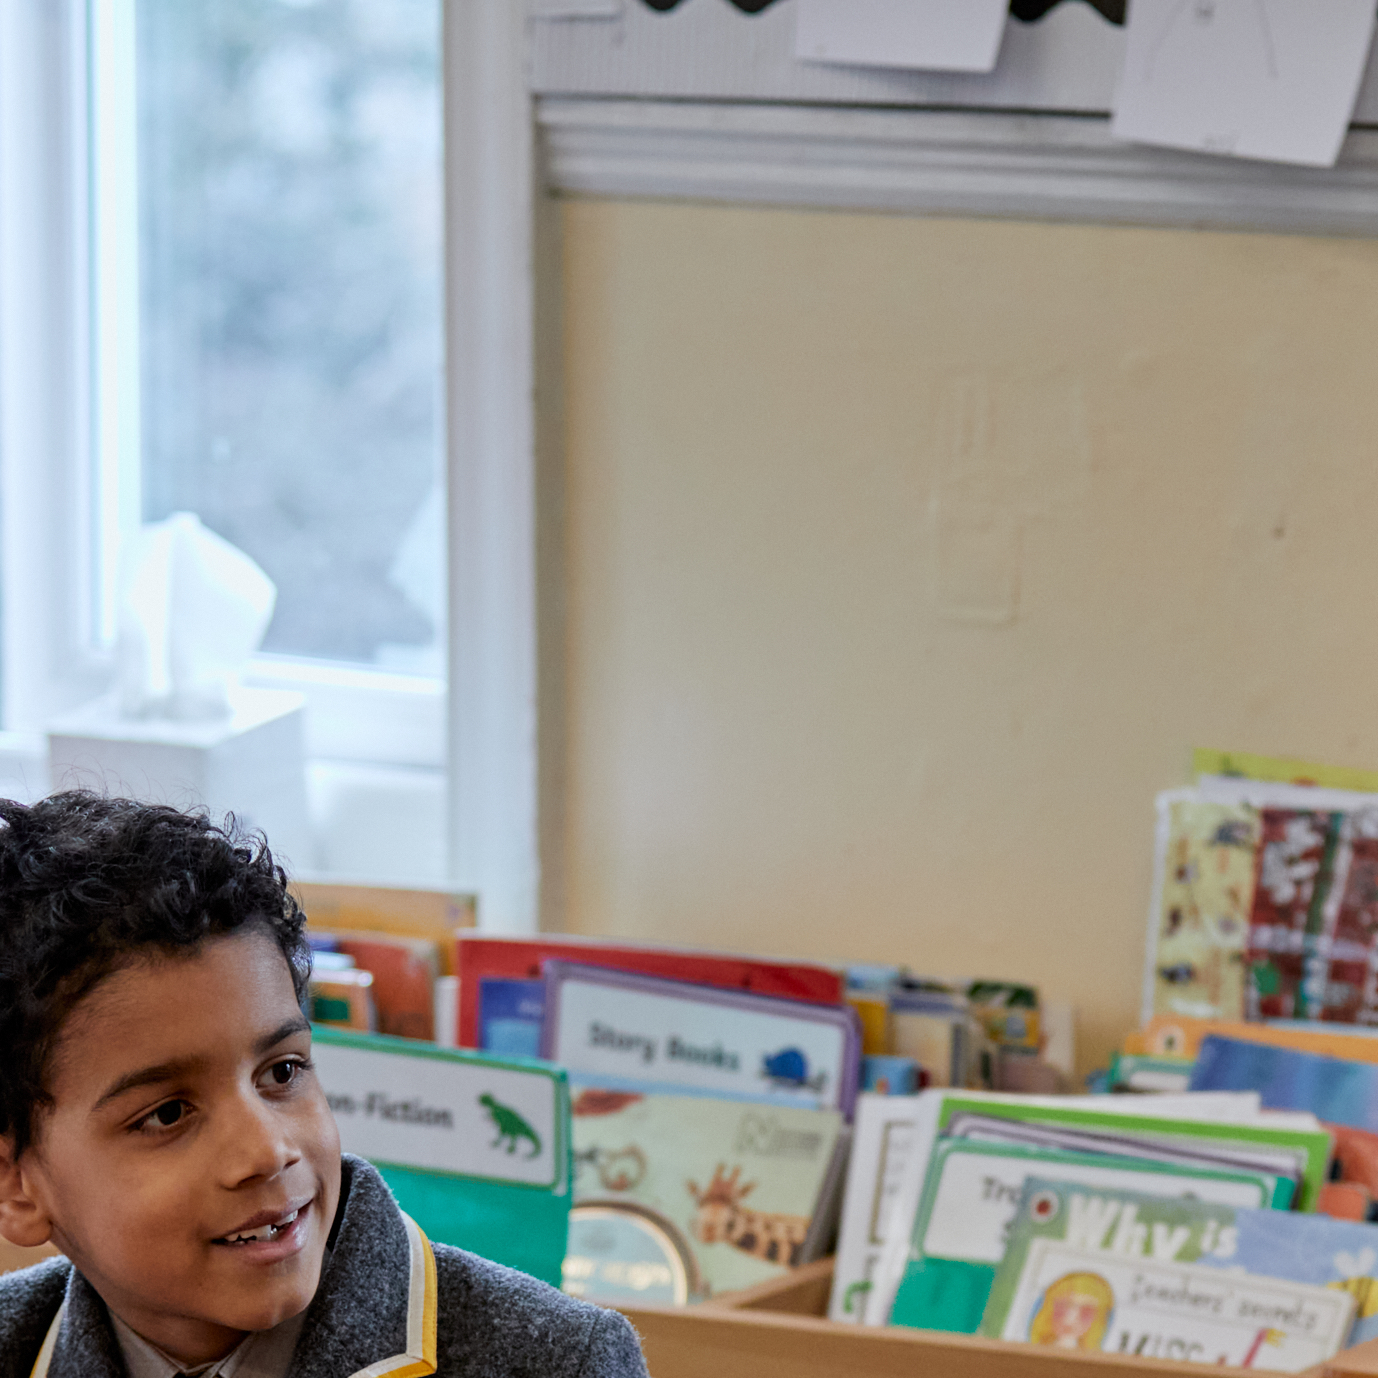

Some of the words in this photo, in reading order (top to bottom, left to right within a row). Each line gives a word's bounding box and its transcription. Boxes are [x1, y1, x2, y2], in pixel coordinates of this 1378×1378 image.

[589, 1020, 655, 1064] Story
[668, 1034, 741, 1072] Books
[325, 1091, 455, 1131] on-Fiction
[1068, 1192, 1193, 1260] Why
